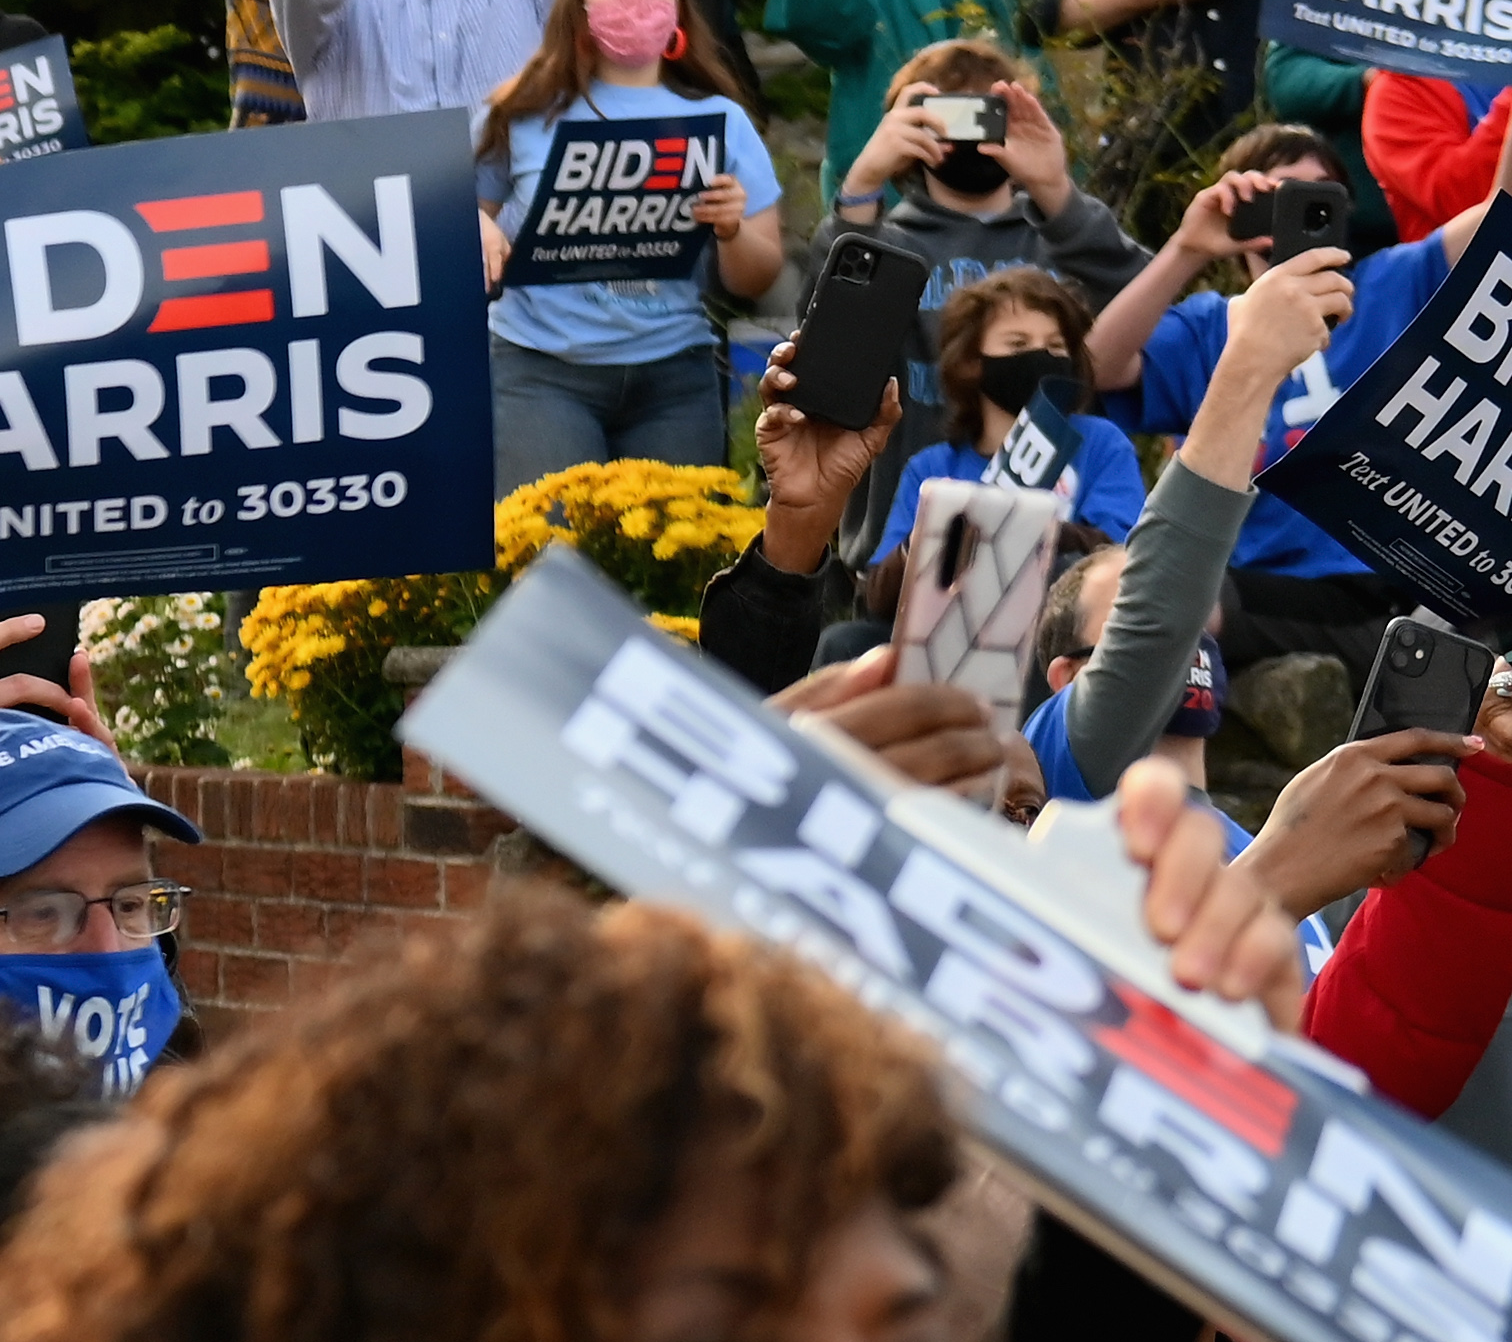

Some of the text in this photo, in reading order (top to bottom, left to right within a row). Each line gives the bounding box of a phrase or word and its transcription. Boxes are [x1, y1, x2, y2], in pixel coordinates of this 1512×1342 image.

[1332, 11, 1417, 49] UNITED
[553, 135, 717, 192] BIDEN
[536, 193, 701, 236] HARRIS
[180, 493, 226, 527] to
[235, 469, 409, 523] 30330
[1338, 450, 1391, 493] Text
[1381, 479, 1480, 559] UNITED
[1468, 548, 1496, 575] to
[36, 981, 151, 1058] VOTE
